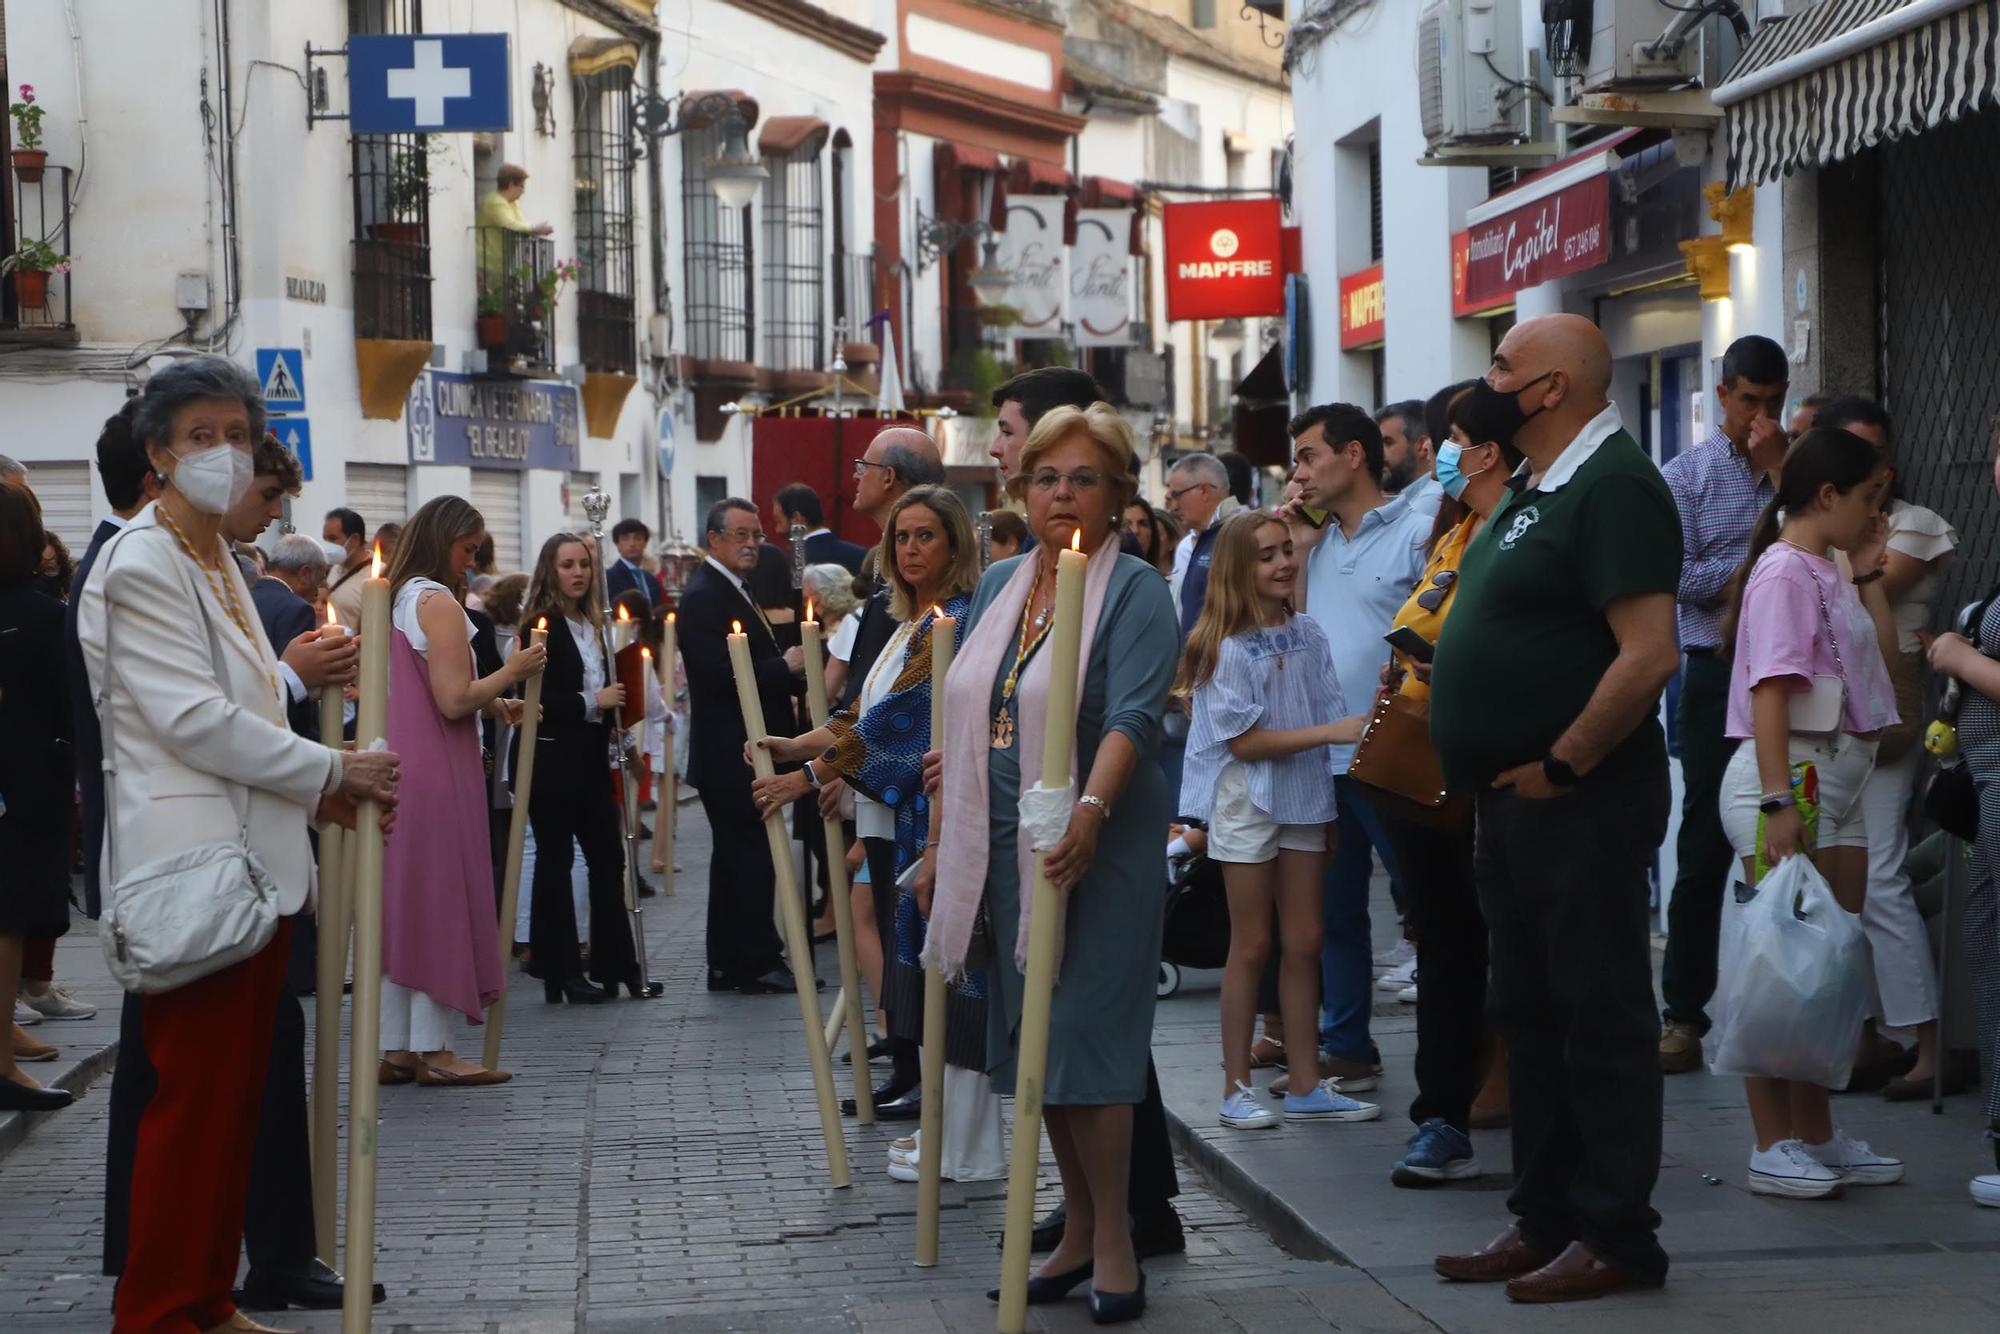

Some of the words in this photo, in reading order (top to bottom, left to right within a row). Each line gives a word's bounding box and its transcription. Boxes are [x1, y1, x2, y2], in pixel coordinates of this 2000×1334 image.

[1504, 197, 1560, 281] Capitel
[1564, 236, 1576, 262] 957
[1577, 230, 1588, 256] 246
[1178, 260, 1272, 279] MAPFRE
[286, 276, 326, 305] REALEJO
[484, 385, 553, 423] VETERINARIA
